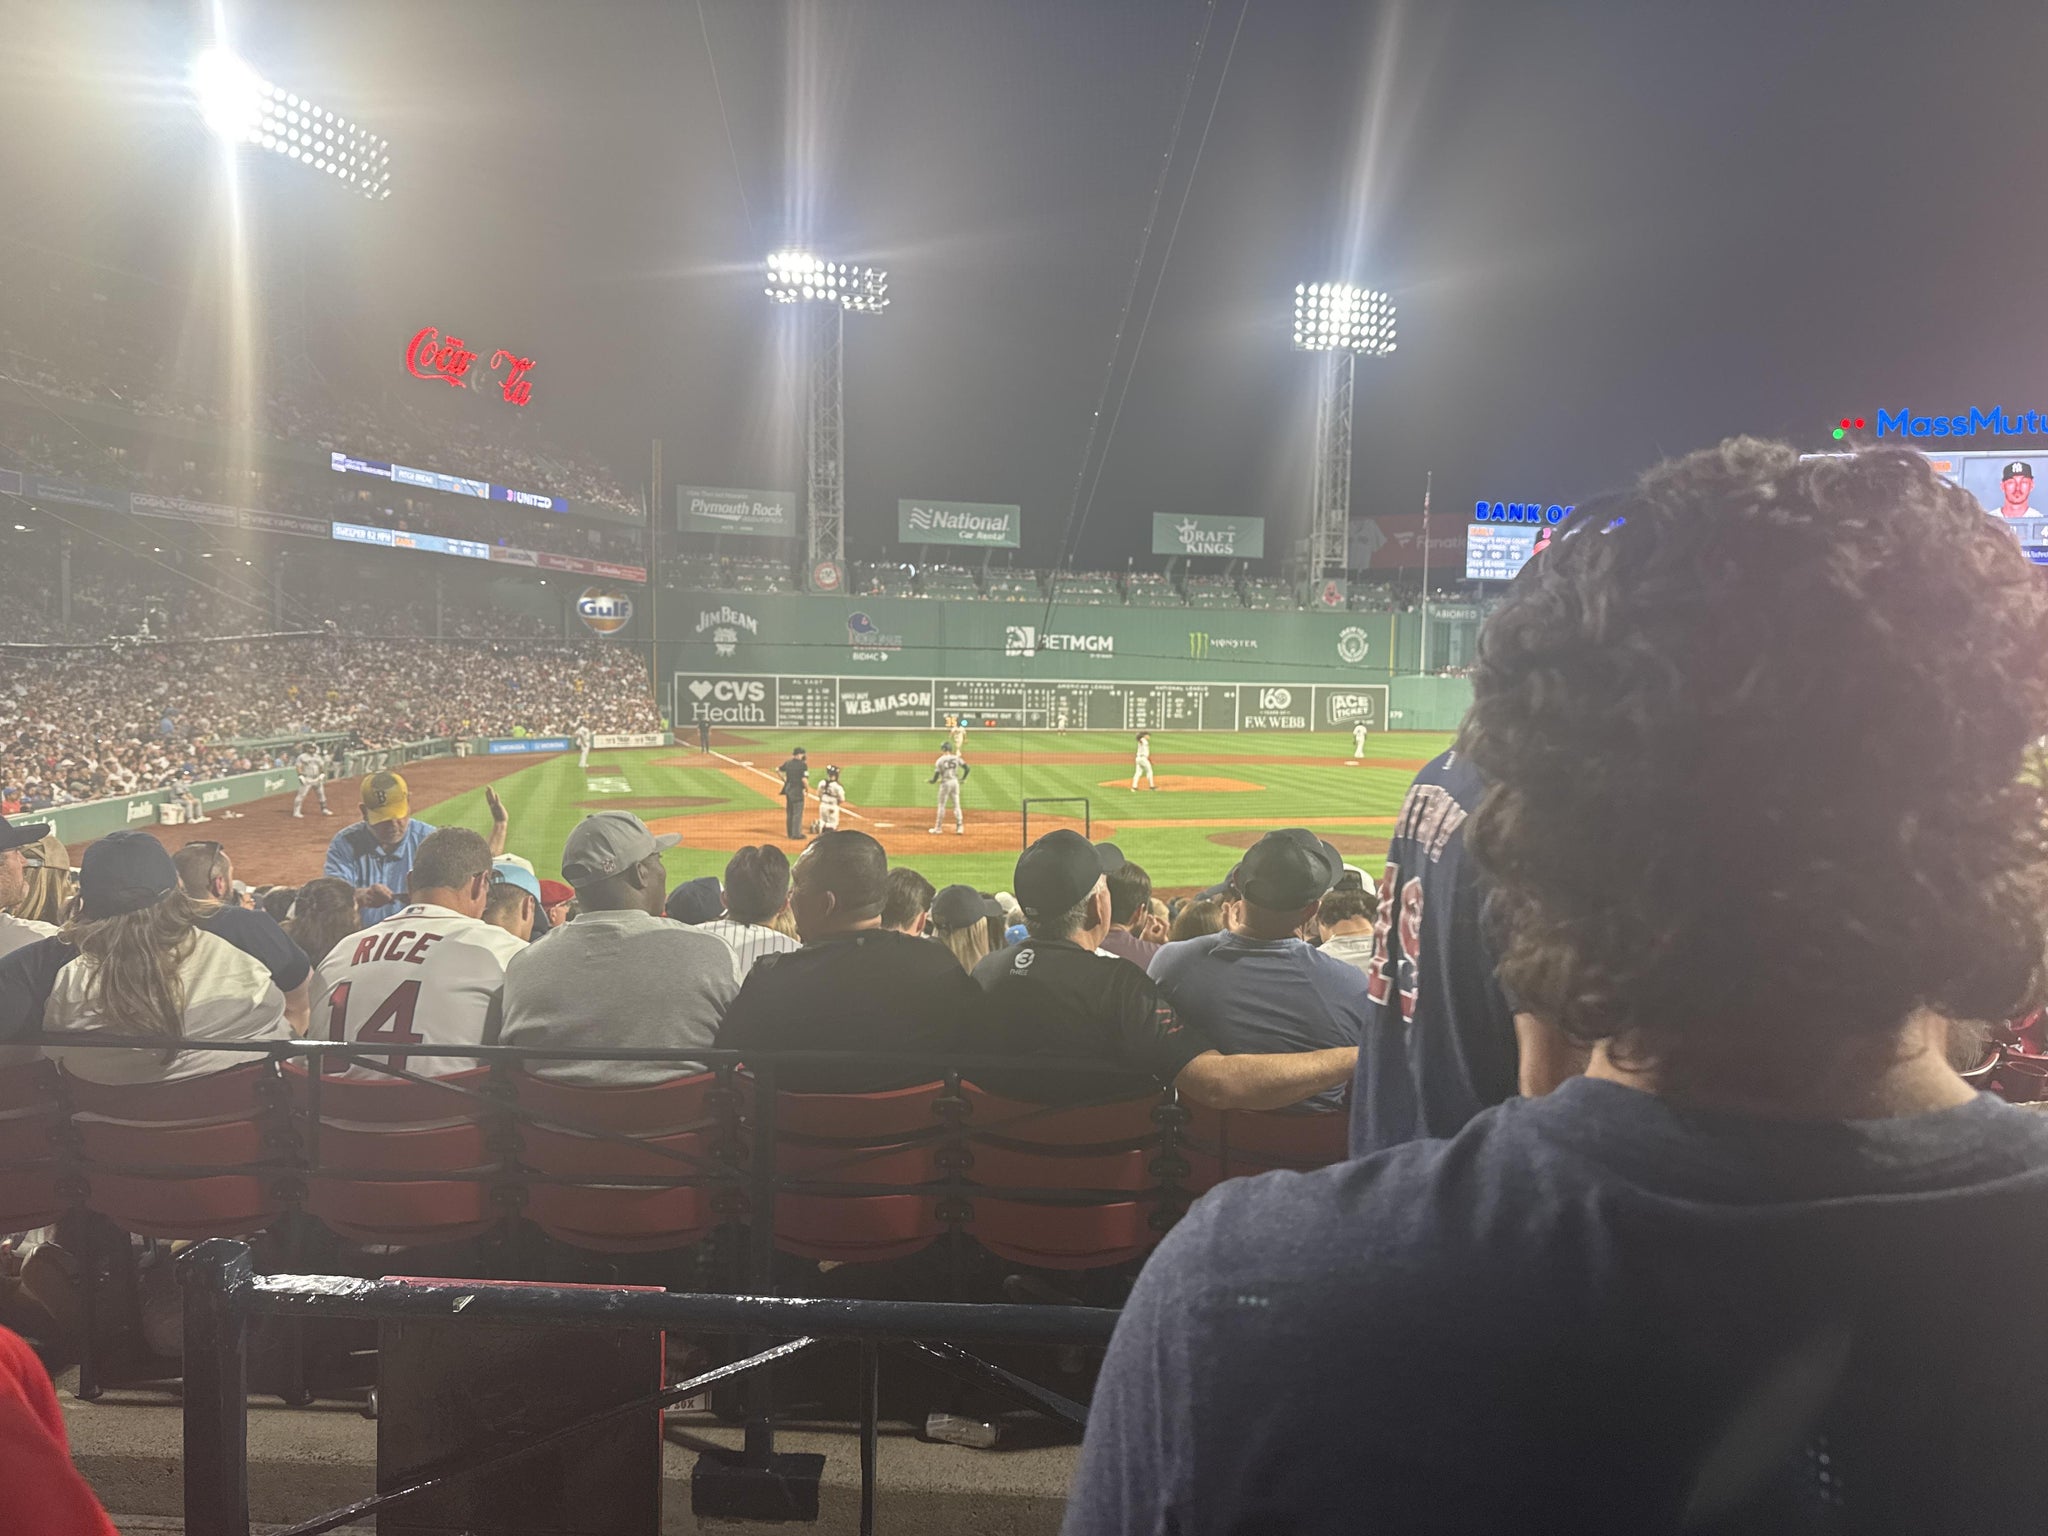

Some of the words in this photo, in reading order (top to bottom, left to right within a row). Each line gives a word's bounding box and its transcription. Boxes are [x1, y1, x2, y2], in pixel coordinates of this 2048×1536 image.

[406, 326, 478, 388] Coca
[516, 491, 552, 509] UNITED
[690, 499, 749, 516] Plymouth
[752, 502, 784, 517] Rock
[1475, 500, 1541, 523] BANK
[932, 511, 1009, 531] National
[959, 531, 974, 539] Car
[1179, 529, 1236, 544] DRAFT
[1186, 542, 1234, 555] KINGS
[579, 599, 629, 617] Gulf
[696, 609, 721, 633] JIM
[721, 606, 757, 636] BEAM
[1209, 638, 1258, 648] MONSTER
[714, 680, 765, 701] CVS
[1336, 695, 1369, 709] ACE
[691, 702, 766, 722] Health
[1337, 707, 1369, 718] TICKET
[1269, 716, 1305, 728] WEBB
[351, 930, 443, 967] RICE
[322, 979, 424, 1074] 14
